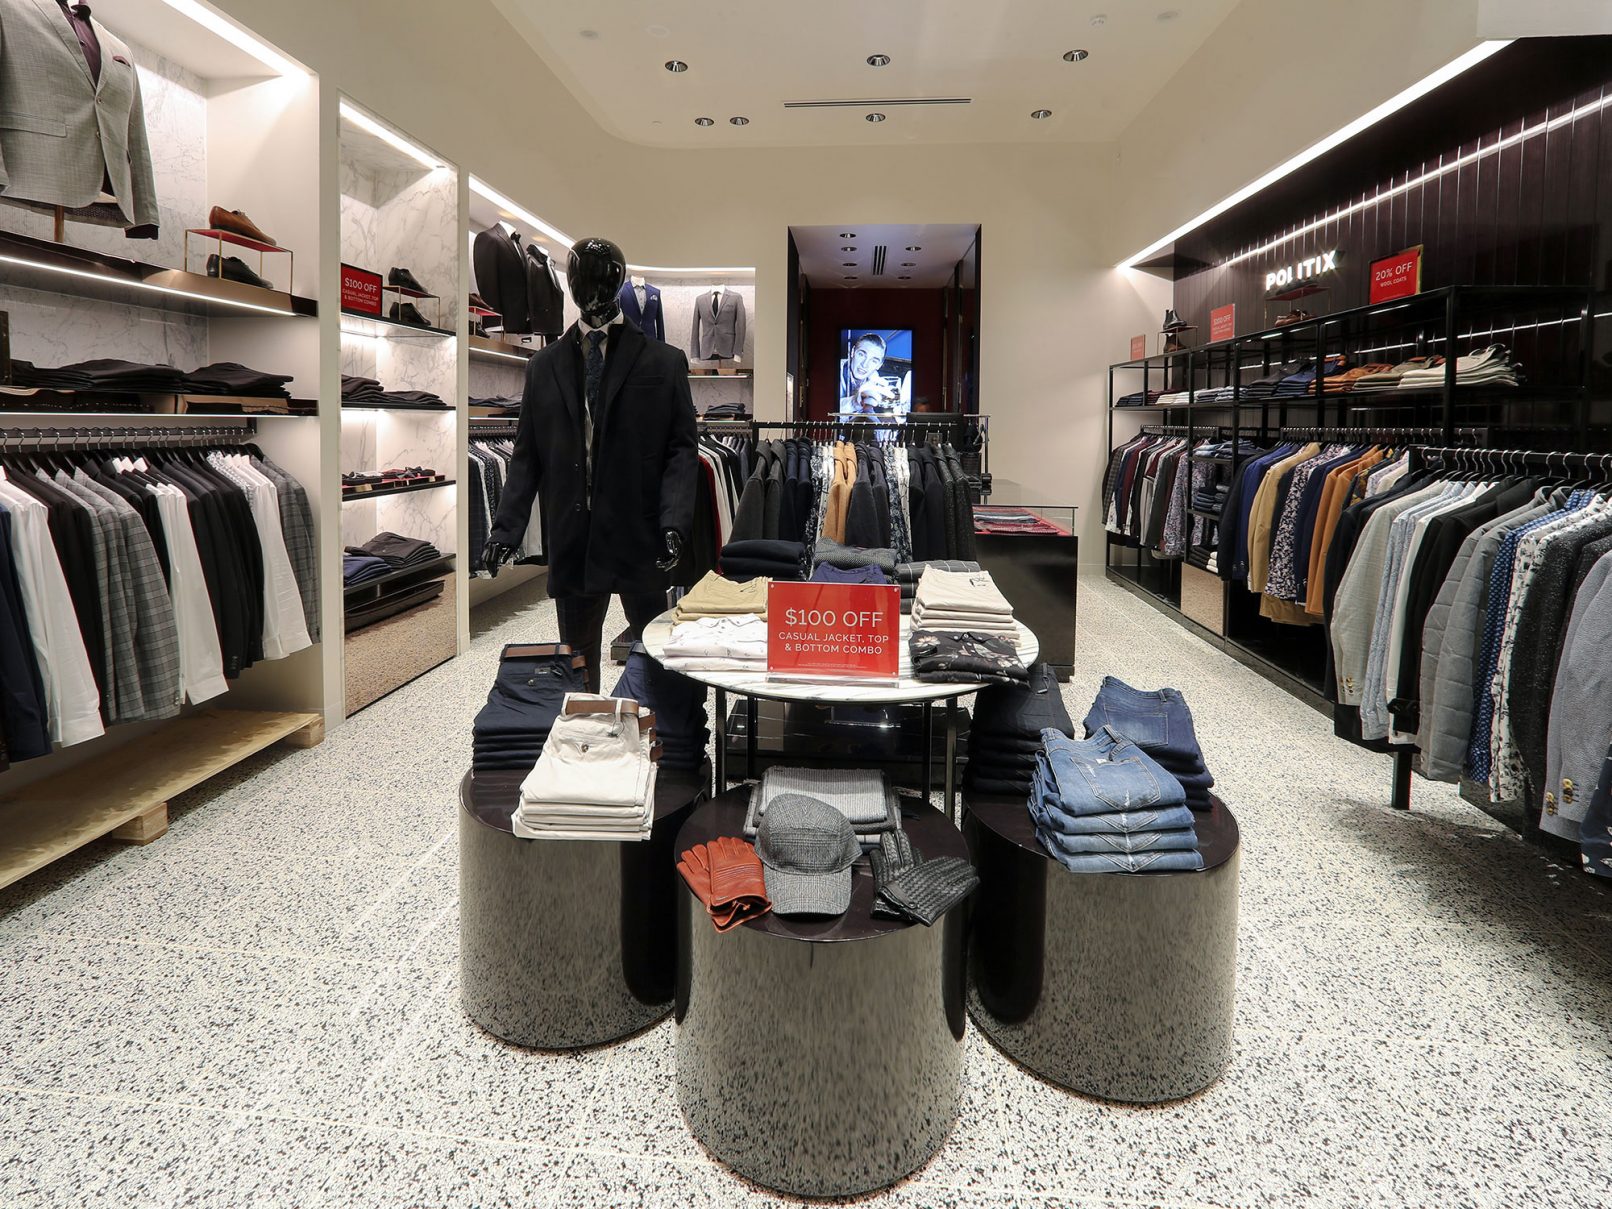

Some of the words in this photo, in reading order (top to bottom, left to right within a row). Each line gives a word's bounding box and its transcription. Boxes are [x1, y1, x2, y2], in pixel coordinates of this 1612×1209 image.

[1266, 250, 1336, 290] POLITIX
[1376, 268, 1393, 281] 20%
[1395, 262, 1413, 275] OFF
[344, 277, 362, 290] $100
[364, 283, 377, 293] OFF
[1393, 276, 1407, 284] COATS
[785, 608, 836, 627] $100
[842, 610, 884, 627] OFF
[778, 632, 820, 641] CASUAL
[868, 634, 889, 643] TOP
[795, 644, 839, 653] BOTTOM
[842, 645, 882, 655] COMBO
